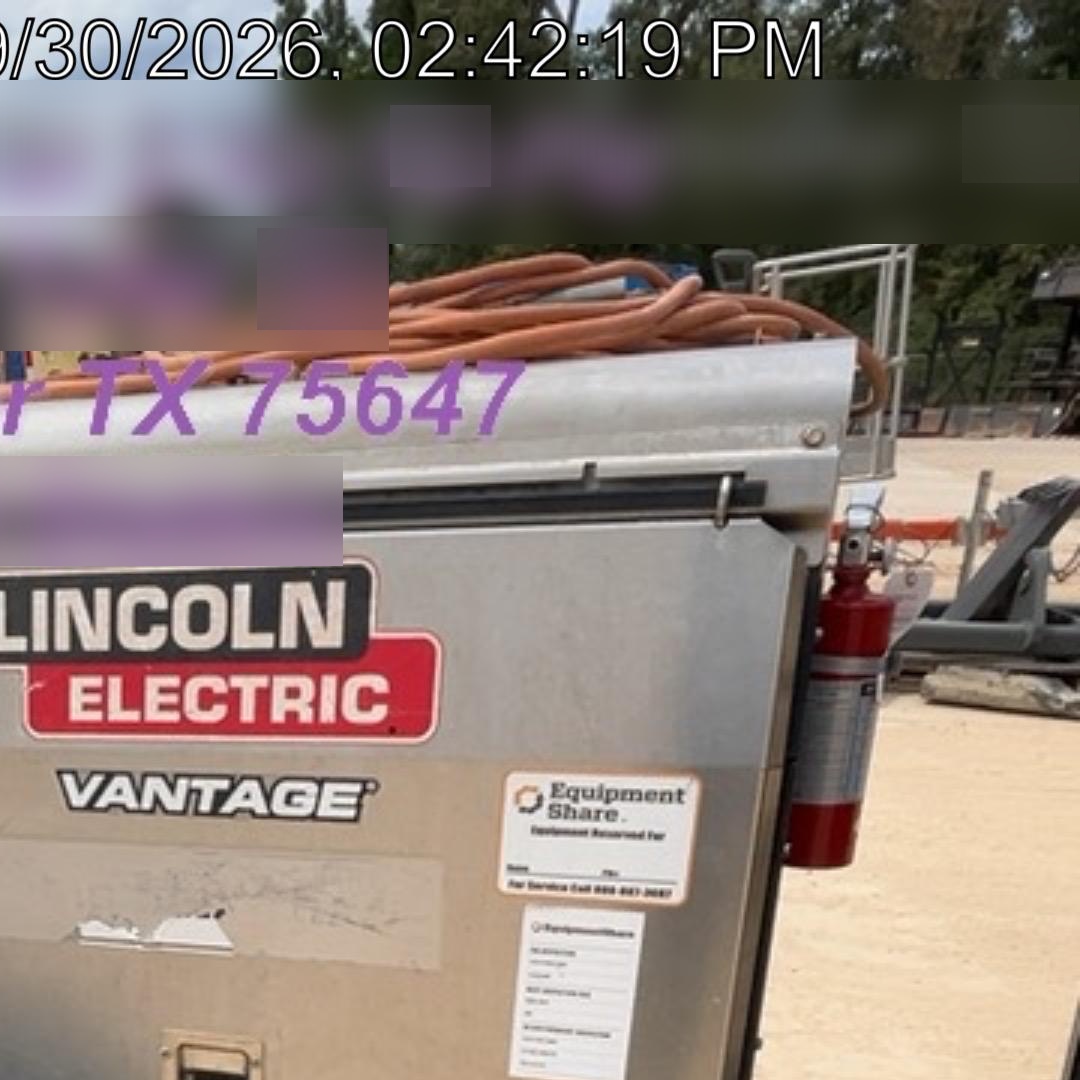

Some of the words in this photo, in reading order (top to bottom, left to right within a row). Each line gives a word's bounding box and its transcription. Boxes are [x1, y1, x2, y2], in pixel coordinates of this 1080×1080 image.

[68, 673, 390, 726] ELECTRIC
[58, 770, 364, 822] VANTAGE
[549, 782, 687, 806] Equipment
